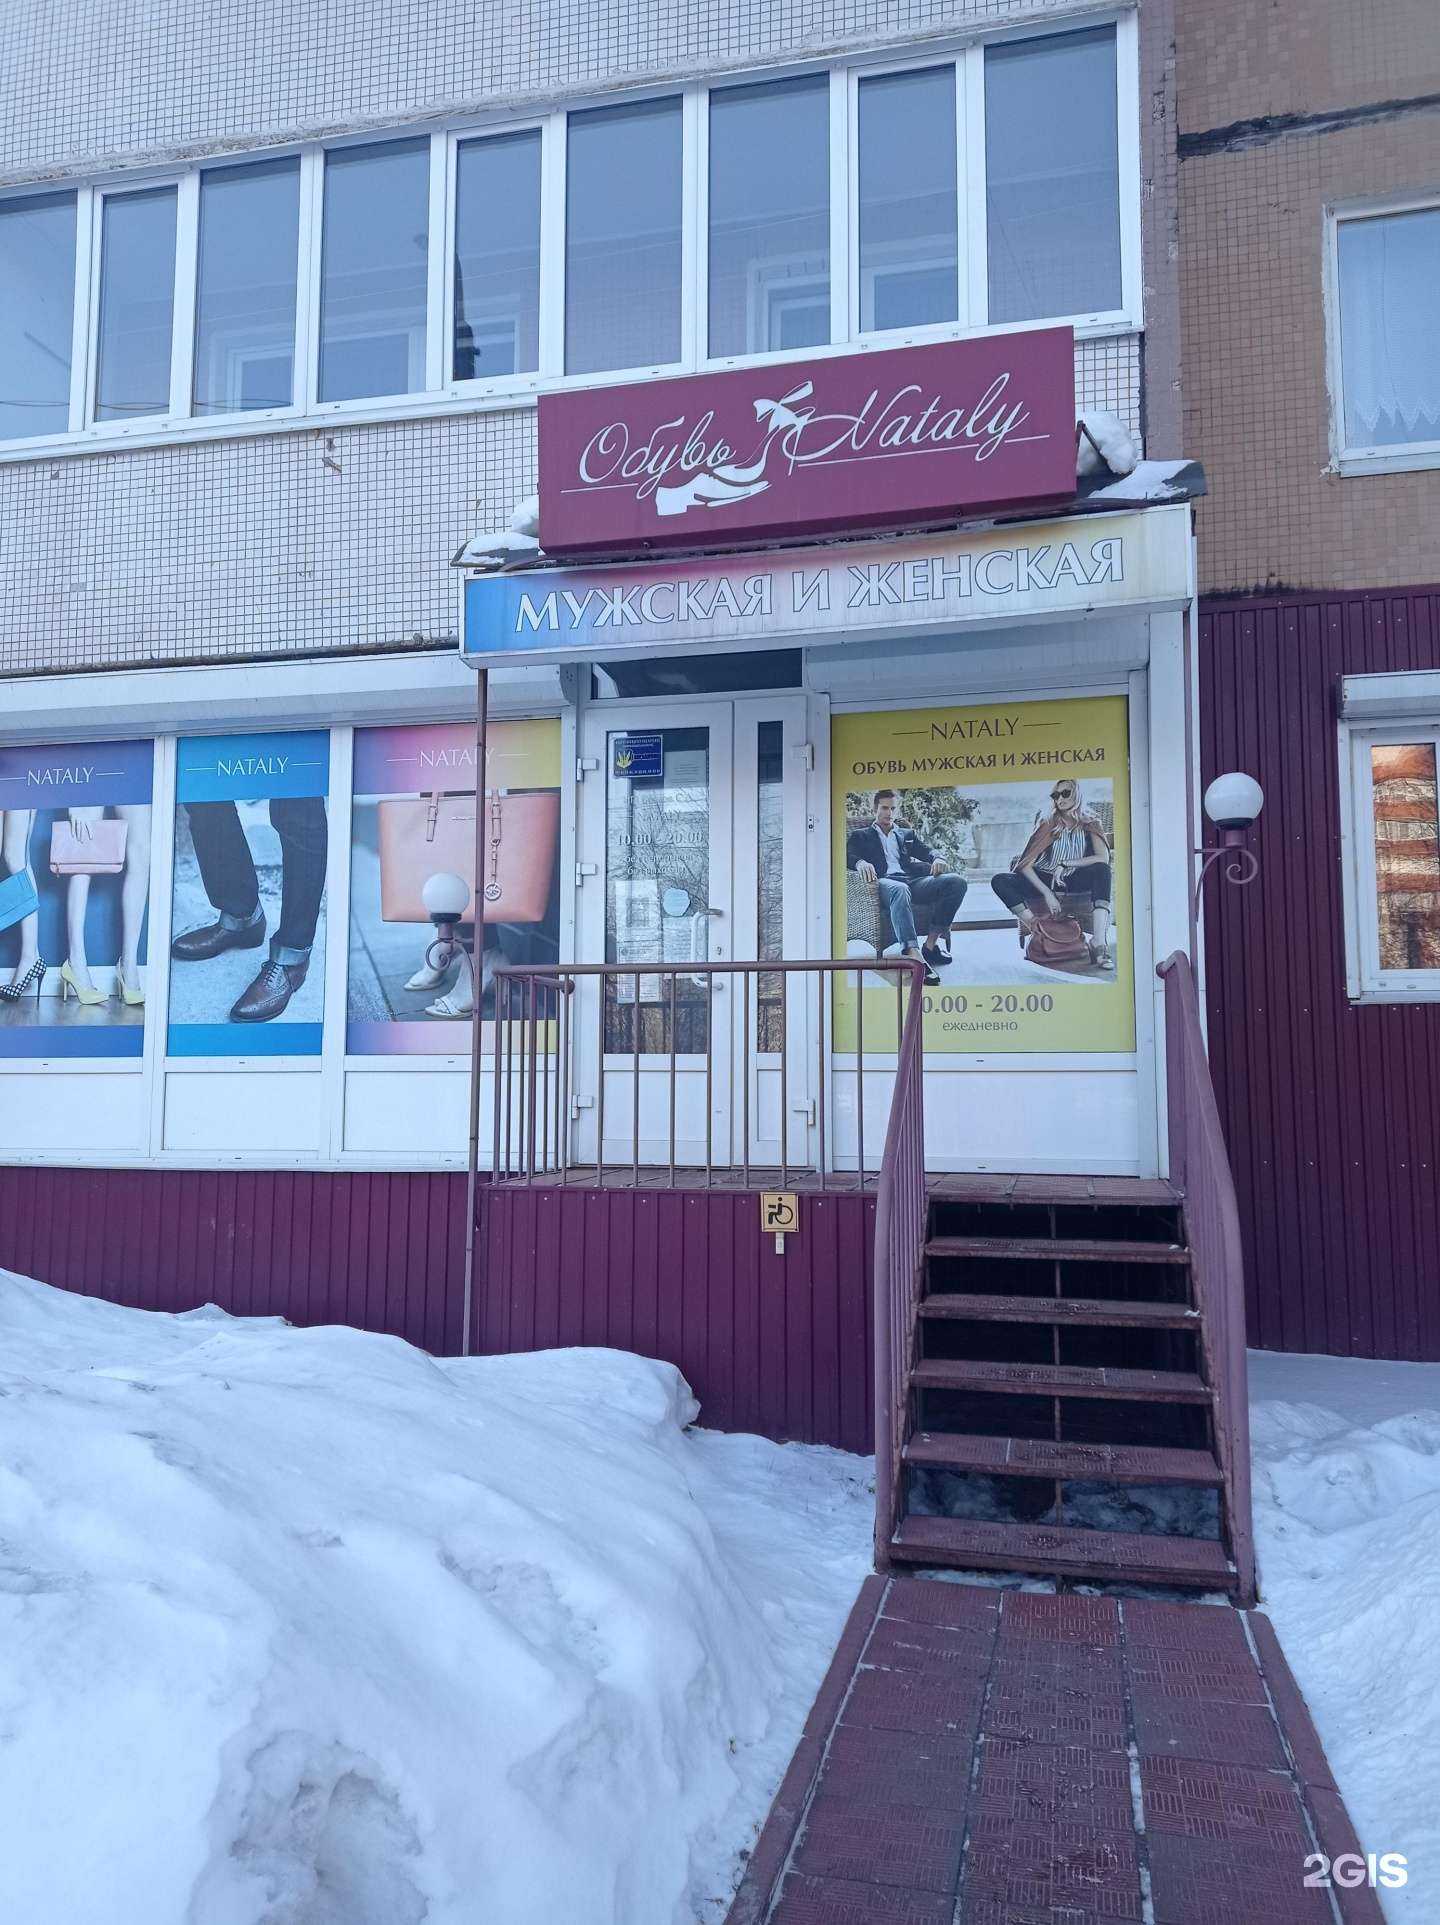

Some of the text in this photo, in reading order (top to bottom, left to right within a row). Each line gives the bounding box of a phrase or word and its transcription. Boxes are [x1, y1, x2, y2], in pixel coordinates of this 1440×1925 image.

[578, 372, 1030, 500] Обувь Nataly
[514, 537, 1125, 633] МУЖСКАЯ И ЖЕНСКАЯ
[930, 717, 1019, 741] NATALY
[217, 756, 289, 777] NATALY
[852, 747, 1106, 776] ОБУВЬ МУЖСКАЯ И ЖЕНСКАЯ
[27, 766, 95, 786] NATALY
[921, 995, 968, 1014] 0.00
[991, 993, 1055, 1013] 20.00
[942, 1020, 1019, 1032] ежедневно
